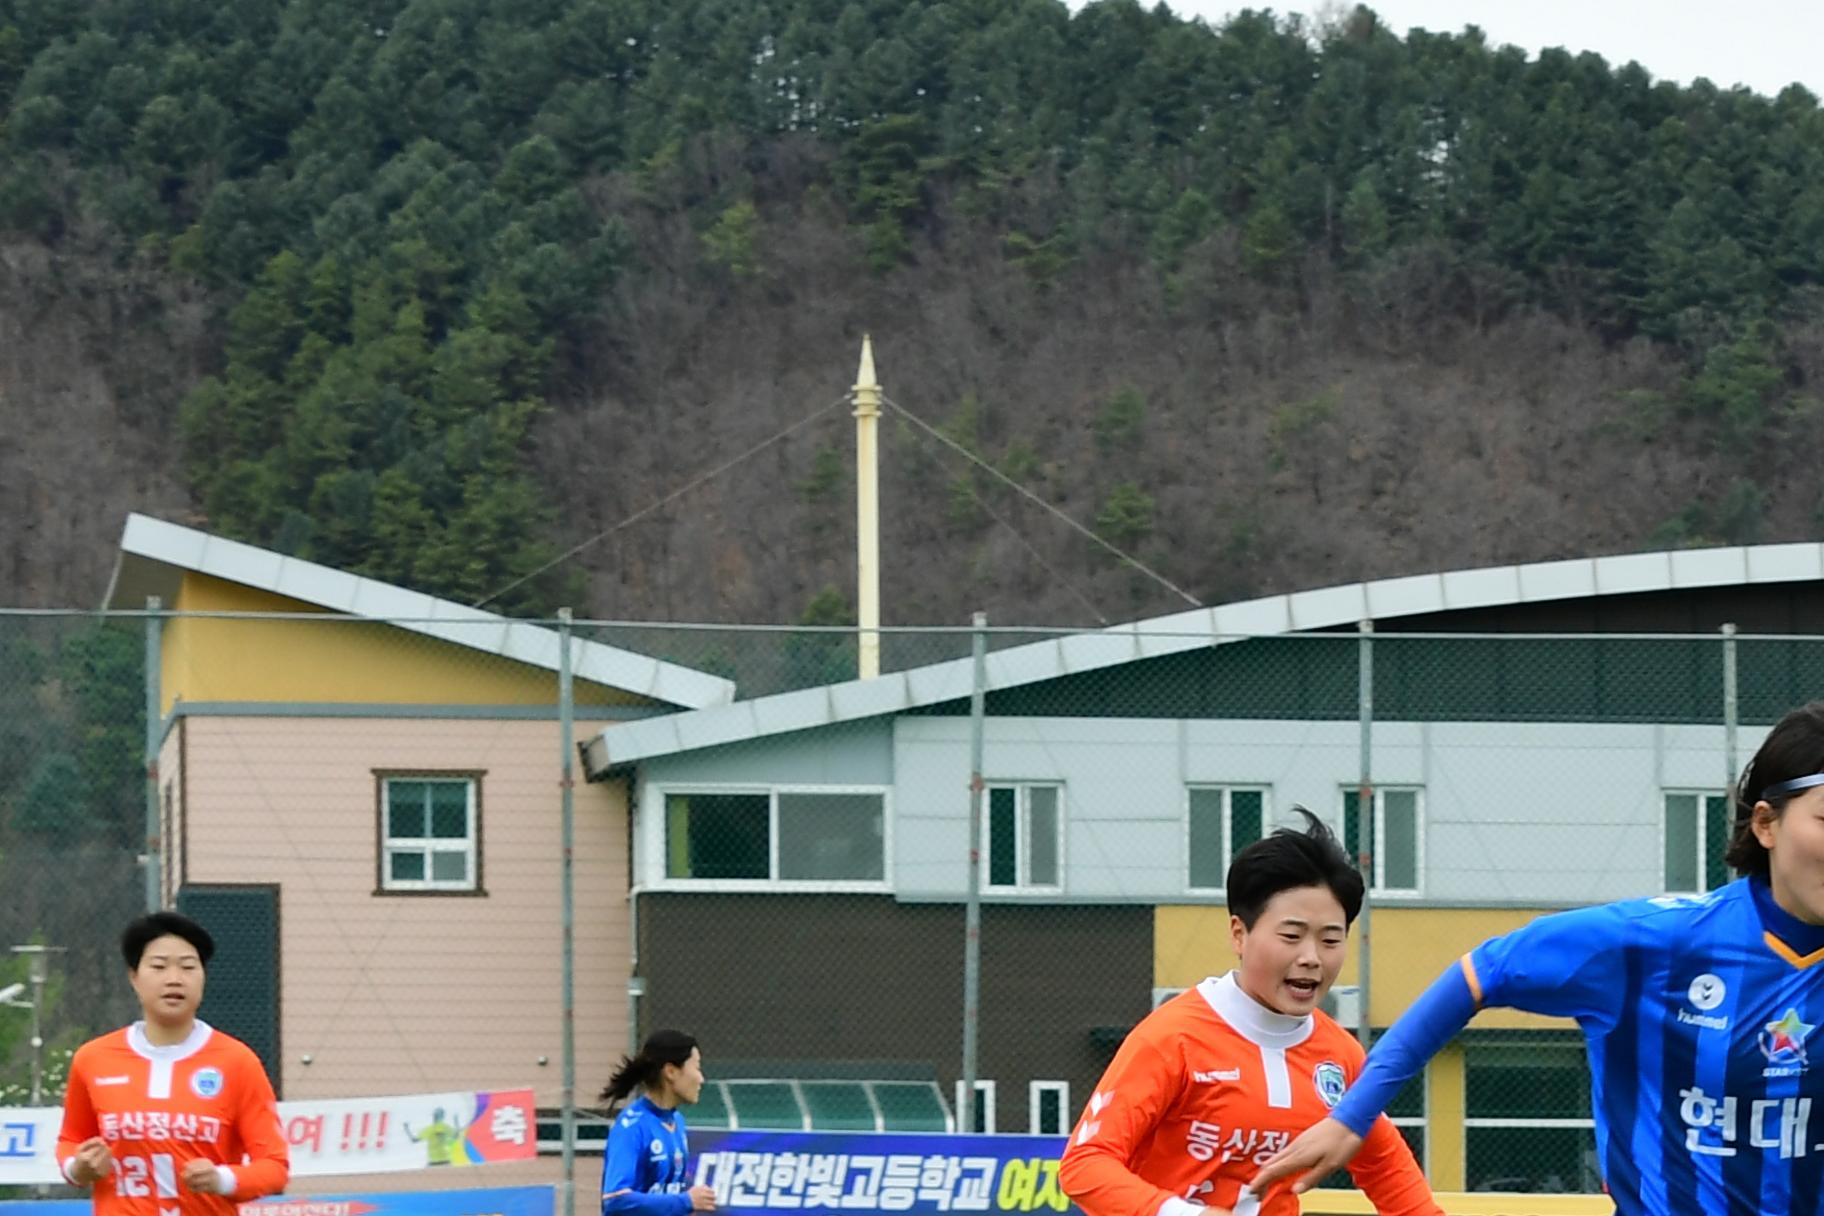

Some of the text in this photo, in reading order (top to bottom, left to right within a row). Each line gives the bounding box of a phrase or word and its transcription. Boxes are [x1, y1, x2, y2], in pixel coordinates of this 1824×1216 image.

[1677, 1008, 1728, 1030] hummel
[102, 1112, 220, 1144] 동산정산고
[287, 1114, 324, 1153] 여
[491, 1104, 528, 1146] 축
[1186, 1120, 1290, 1167] 동산정
[695, 1150, 998, 1212] 대전한빛고등학교
